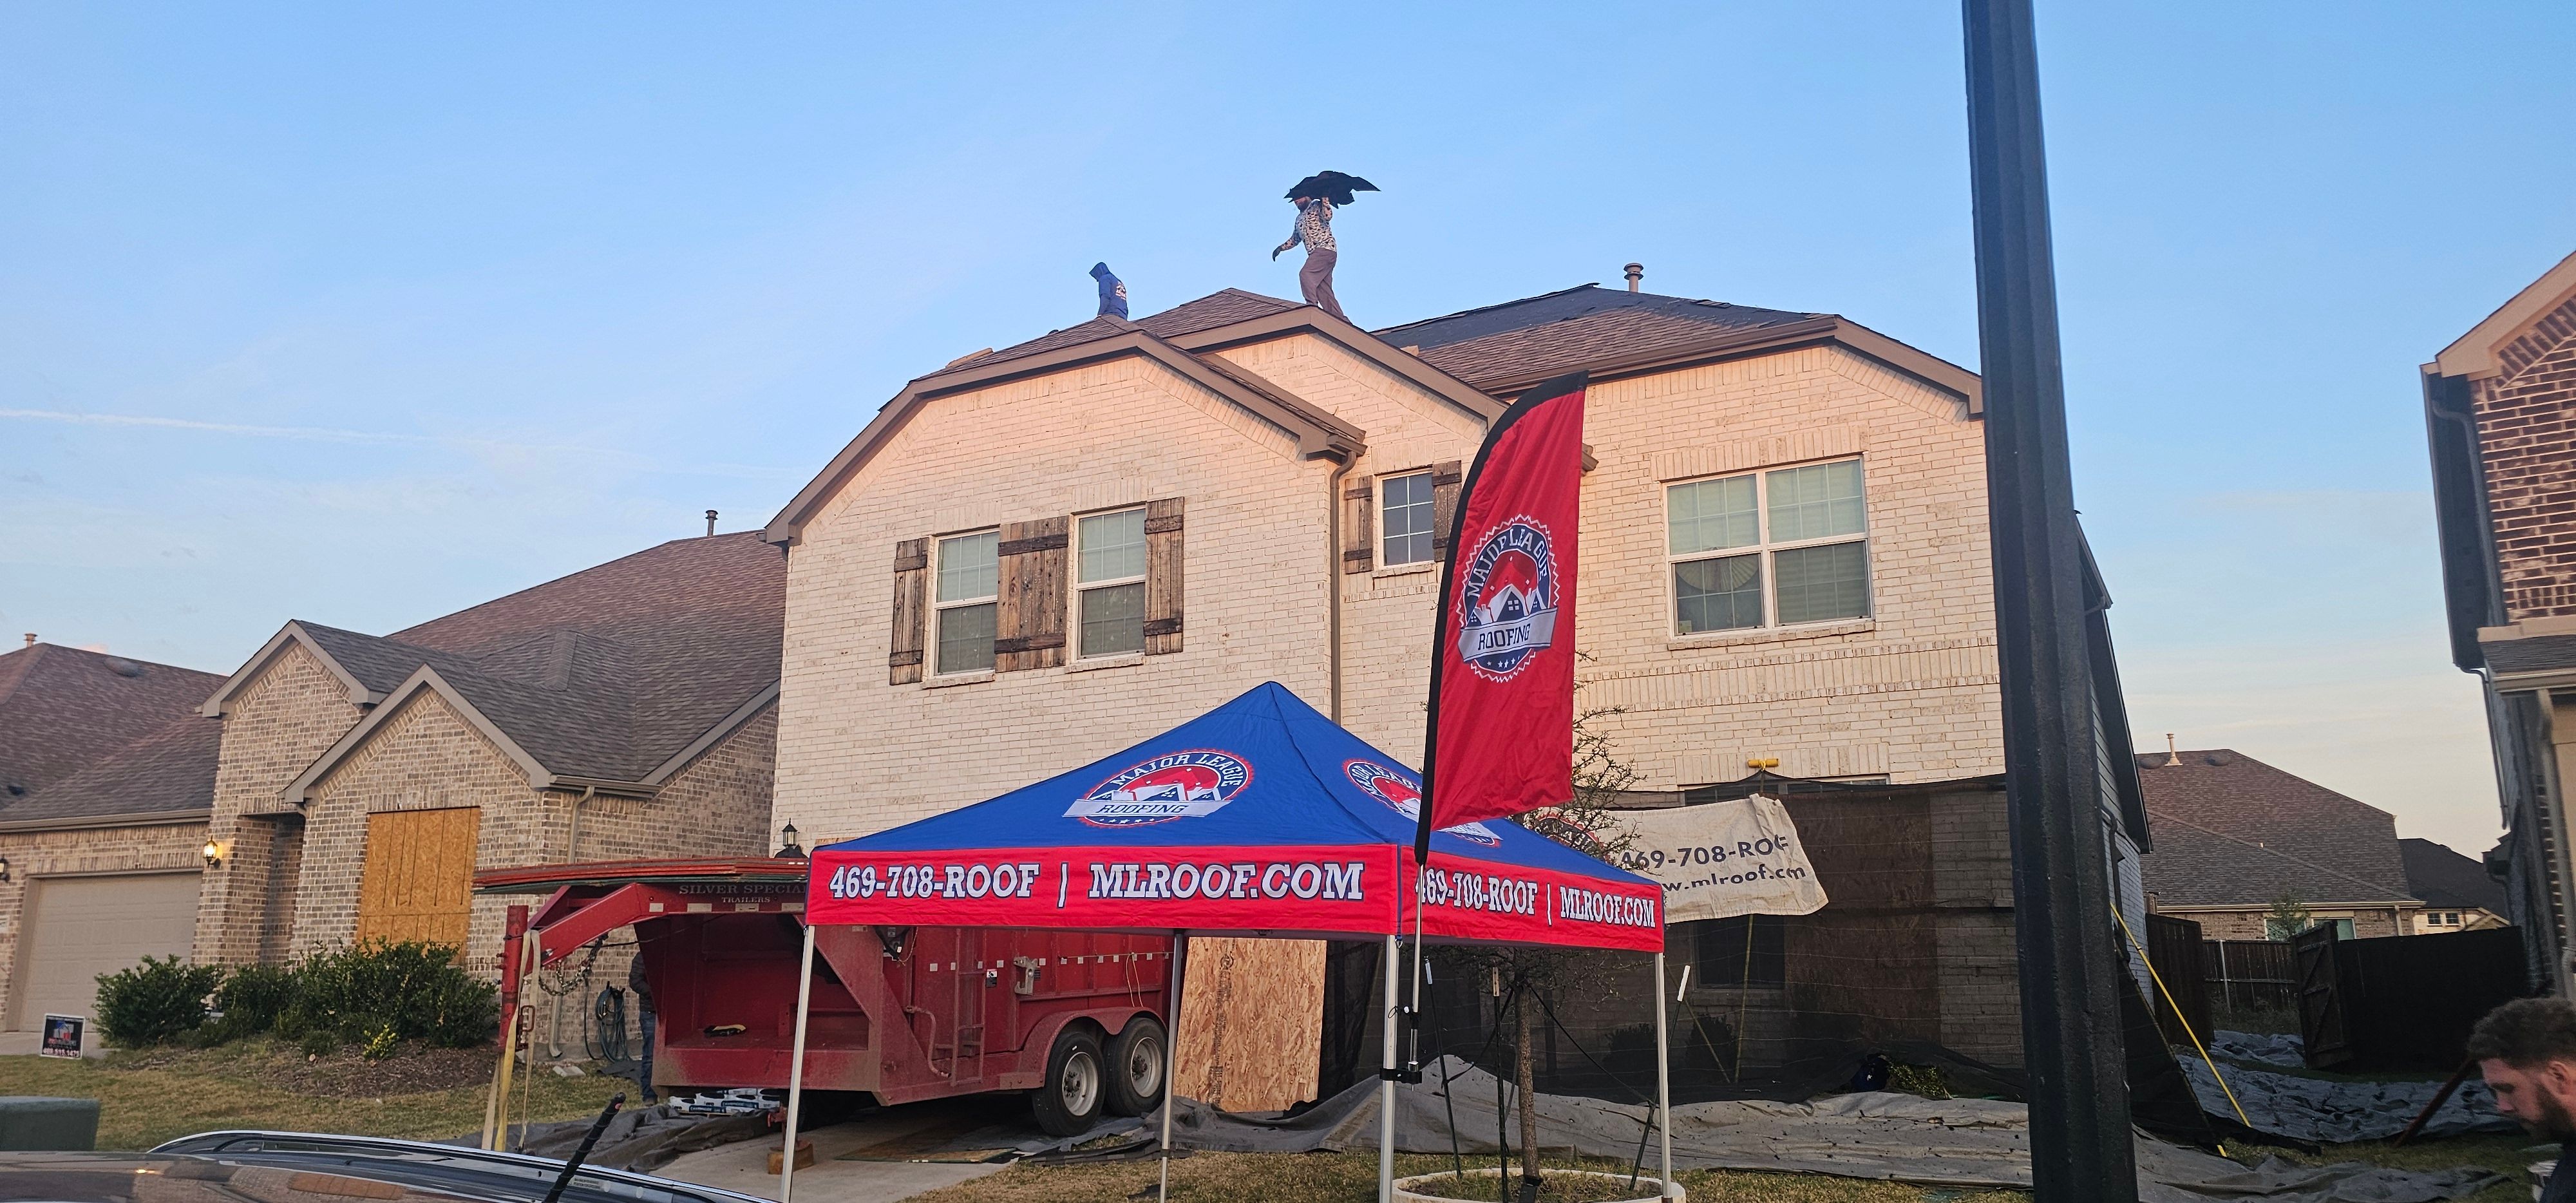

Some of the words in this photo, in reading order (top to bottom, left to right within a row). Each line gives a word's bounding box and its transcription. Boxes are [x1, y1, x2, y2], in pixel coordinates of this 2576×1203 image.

[1468, 536, 1507, 598] MAJOR
[1509, 528, 1548, 581] LEAGUE
[1477, 623, 1531, 650] ROOFING
[1110, 754, 1191, 786] MAJOR
[1195, 753, 1242, 787] LEAGUE
[1096, 804, 1189, 813] ROOFING
[679, 884, 738, 895] SILVER
[829, 864, 1039, 898] 469-708-ROOF
[1088, 862, 1364, 900] MLROOF.COM
[1560, 886, 1656, 928] MLROOF.COM
